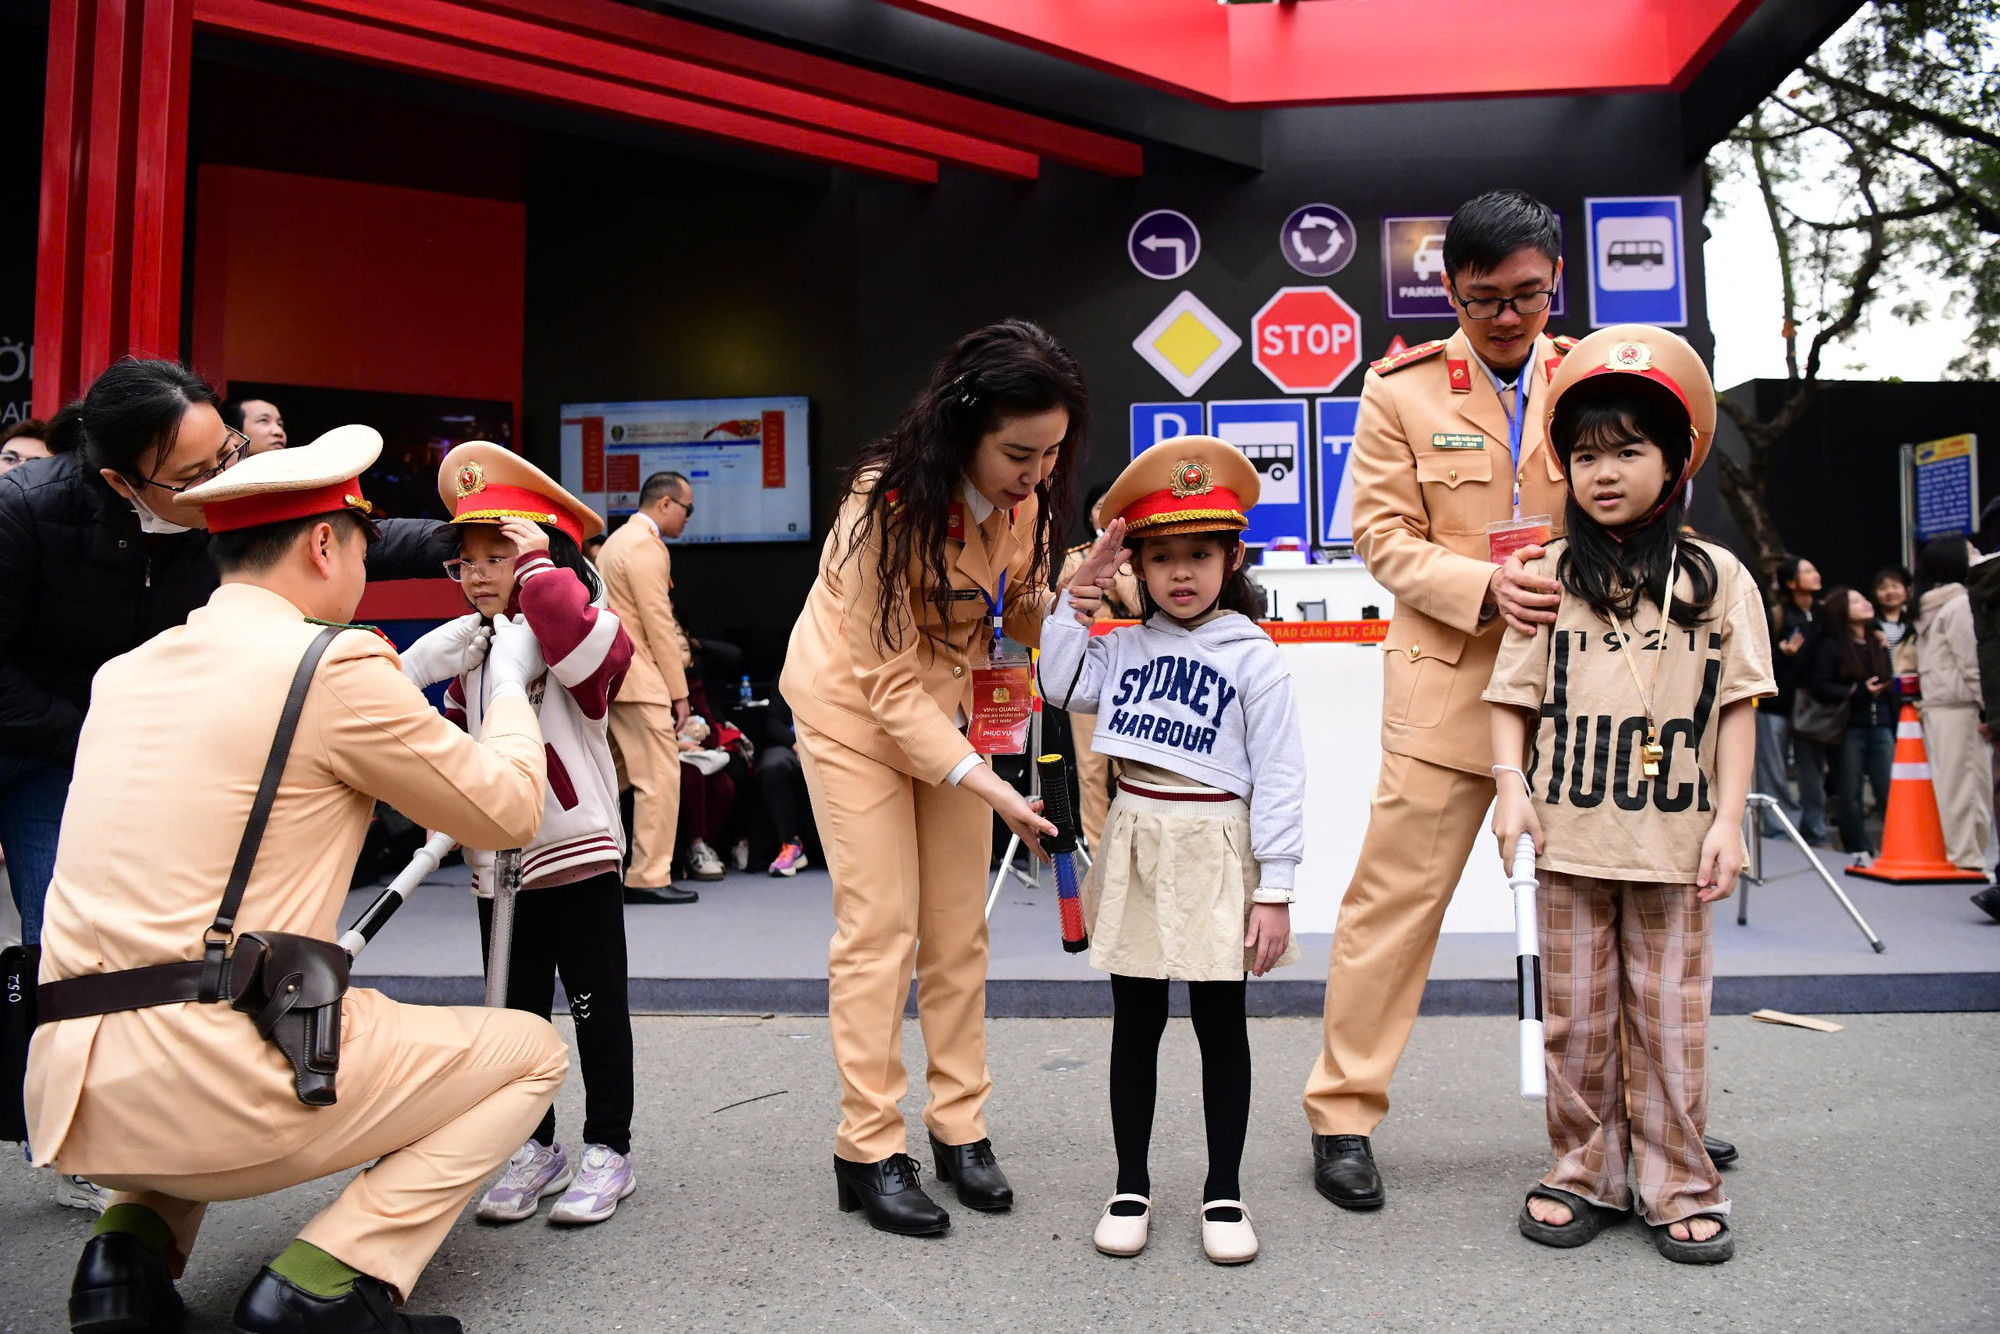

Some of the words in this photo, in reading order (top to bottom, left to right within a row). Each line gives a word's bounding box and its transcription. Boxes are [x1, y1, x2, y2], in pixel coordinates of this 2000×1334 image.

[1399, 286, 1448, 298] PARKIN
[1263, 324, 1352, 355] STOP
[1574, 629, 1696, 652] 1921
[1112, 655, 1236, 728] SYDNEY
[983, 730, 1001, 738] PHỤC
[1002, 730, 1012, 738] VỤ
[1108, 708, 1217, 754] HARBOUR
